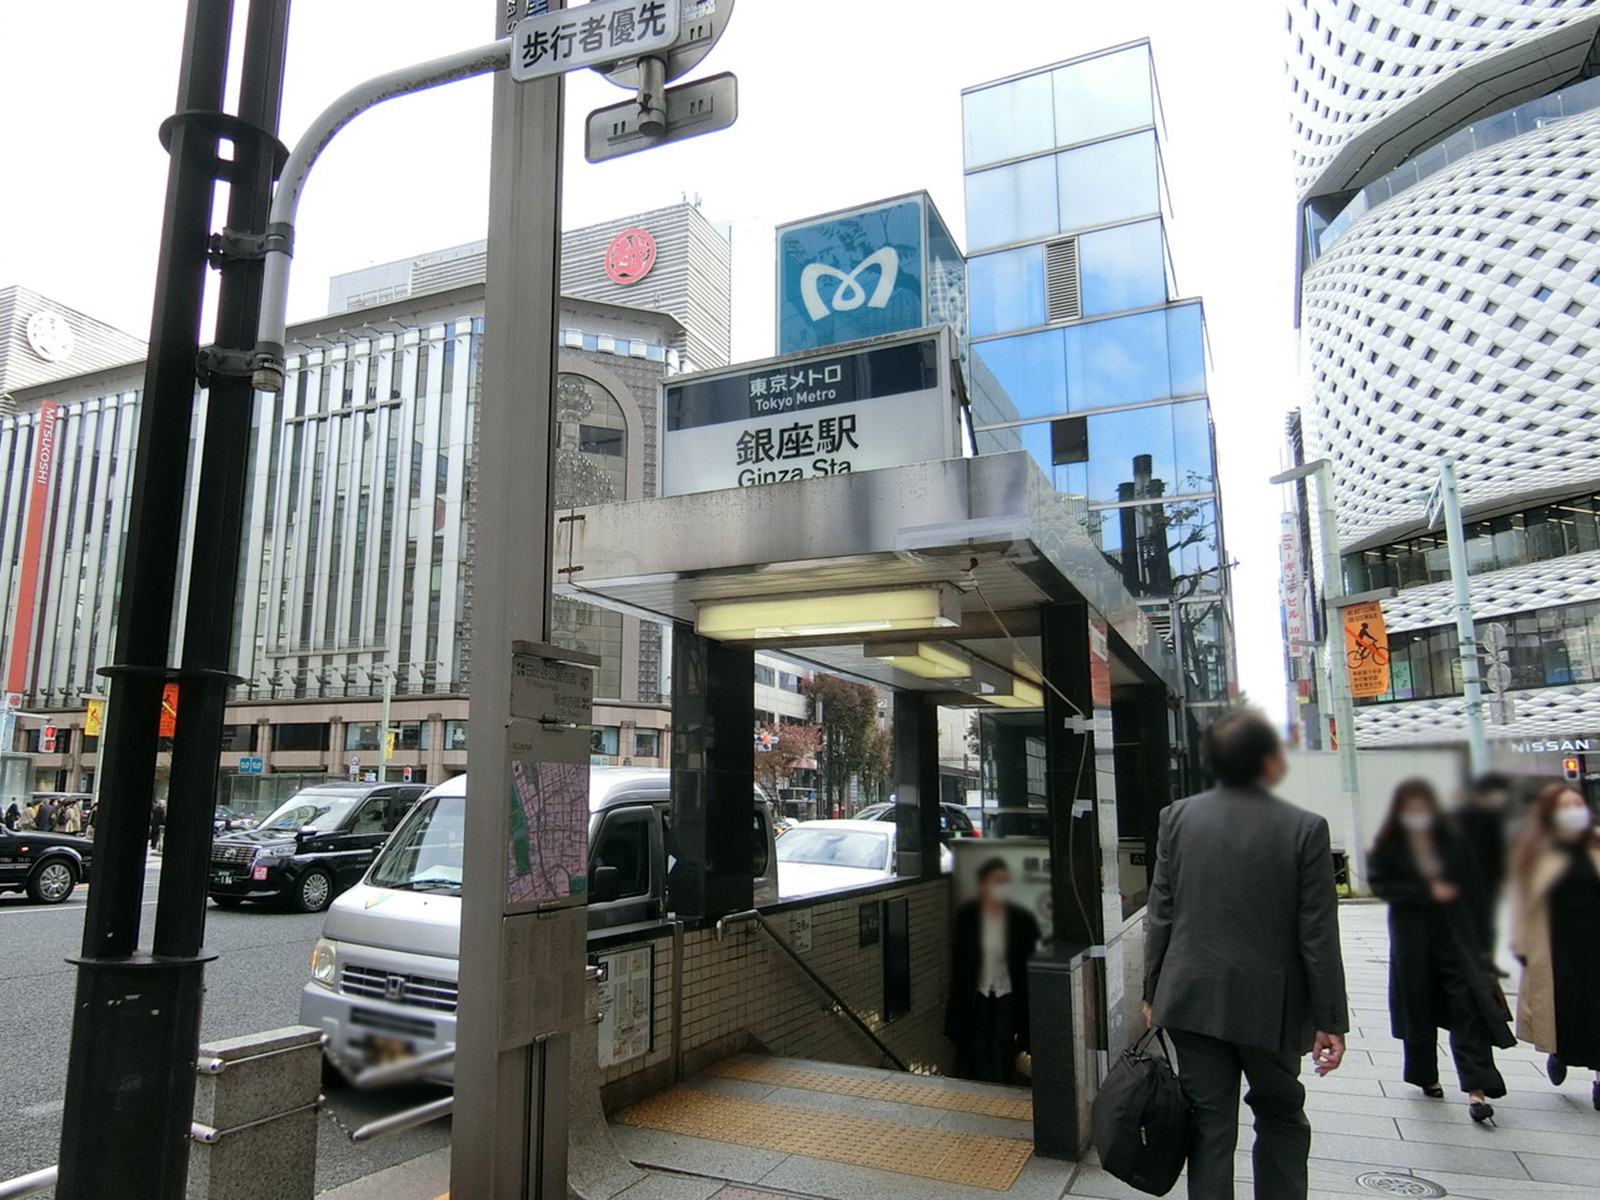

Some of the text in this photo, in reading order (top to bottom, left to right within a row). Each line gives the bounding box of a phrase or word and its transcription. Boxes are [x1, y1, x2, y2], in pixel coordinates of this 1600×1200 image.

[522, 3, 666, 69] 歩行者優先
[749, 364, 842, 397] 東京メトロ
[755, 388, 836, 412] Tokyo Metro
[36, 406, 56, 485] MITSUKOSHI
[736, 414, 860, 467] 銀座駅
[738, 466, 804, 488] Ginza
[1511, 739, 1590, 753] NISSAN
